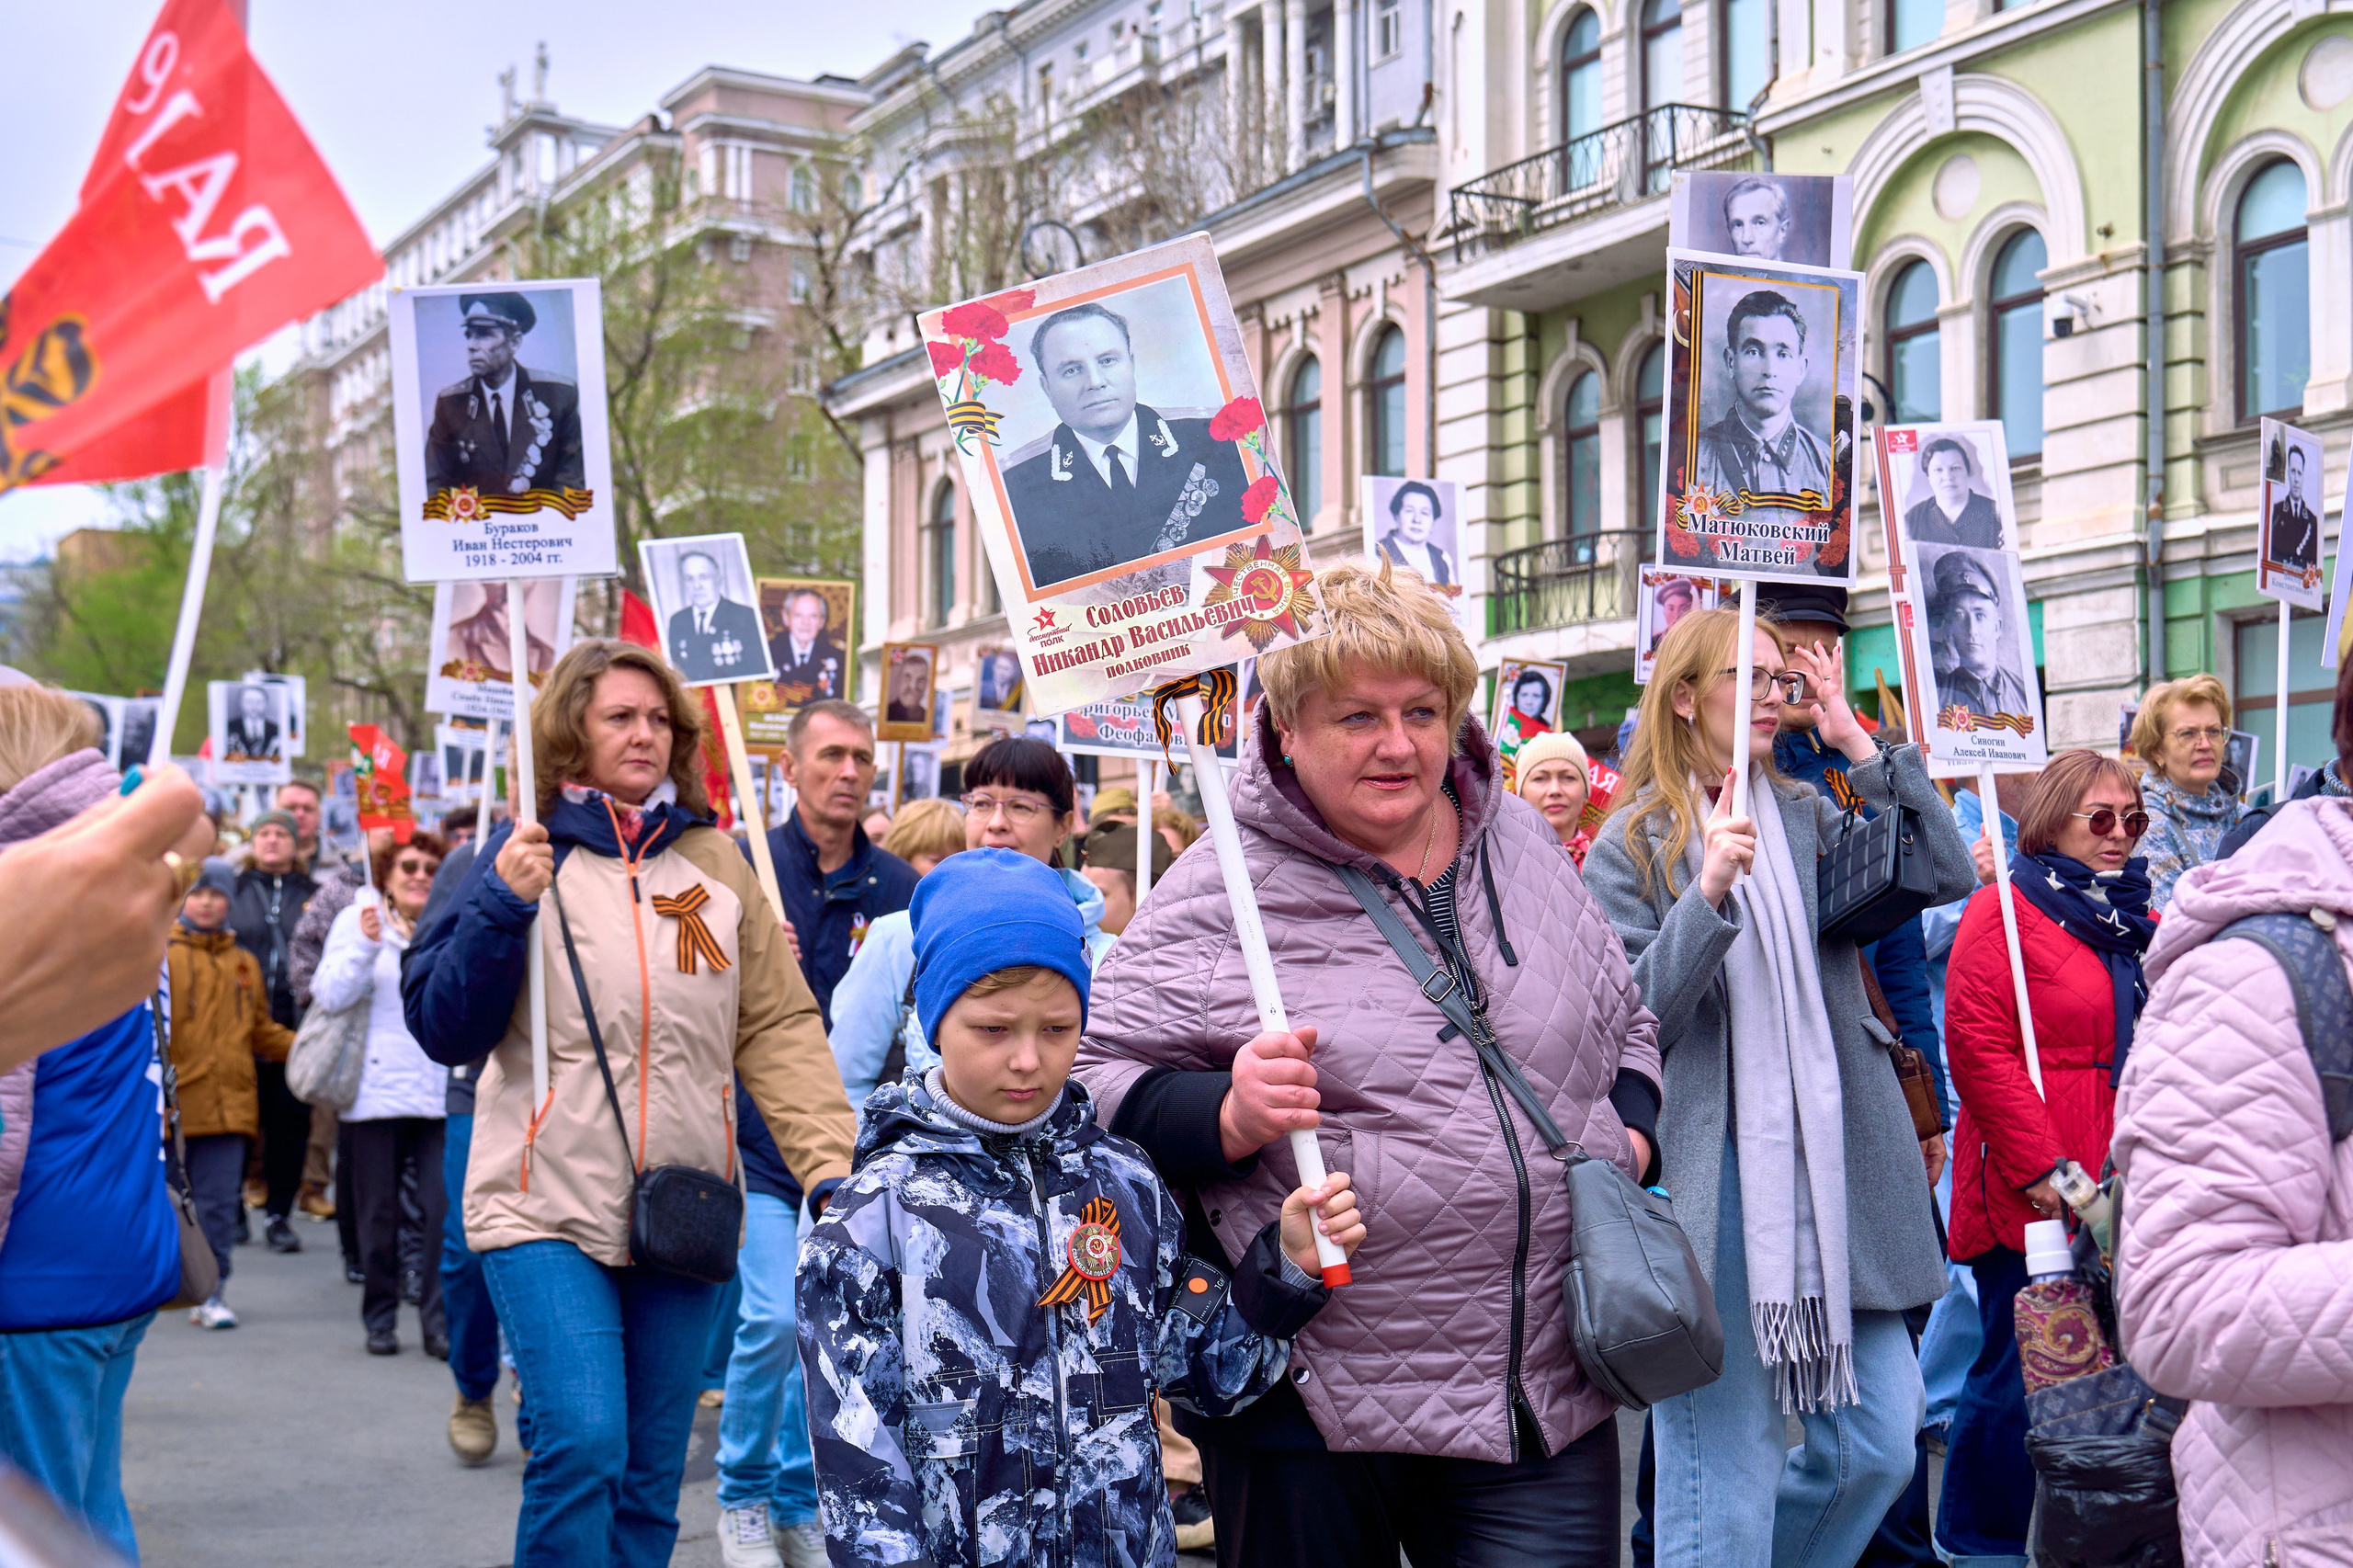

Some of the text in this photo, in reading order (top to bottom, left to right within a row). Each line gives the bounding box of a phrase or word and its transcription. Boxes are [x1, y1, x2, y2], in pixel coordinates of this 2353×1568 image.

[122, 30, 180, 114] 9
[484, 522, 539, 537] Бураков
[1688, 512, 1829, 542] Матюковский
[452, 538, 573, 551] Иван Нестерович
[1719, 540, 1795, 565] Матвей
[466, 554, 496, 567] 1918
[511, 552, 542, 565] 2004
[1233, 561, 1292, 615] ЧЕСТВЕННАЯ ВОЙНА
[1086, 585, 1185, 629] Соловьев
[1031, 596, 1257, 676] Никандр Васильевич
[1040, 635, 1064, 648] ПОЛК
[1105, 643, 1191, 679] полковник
[1082, 702, 1154, 721] ригорье
[1971, 735, 2006, 746] Синогин
[1953, 746, 2027, 760] Алексей Иванович
[1589, 764, 1620, 794] АЯ
[1071, 1248, 1086, 1272] СПАСИБО
